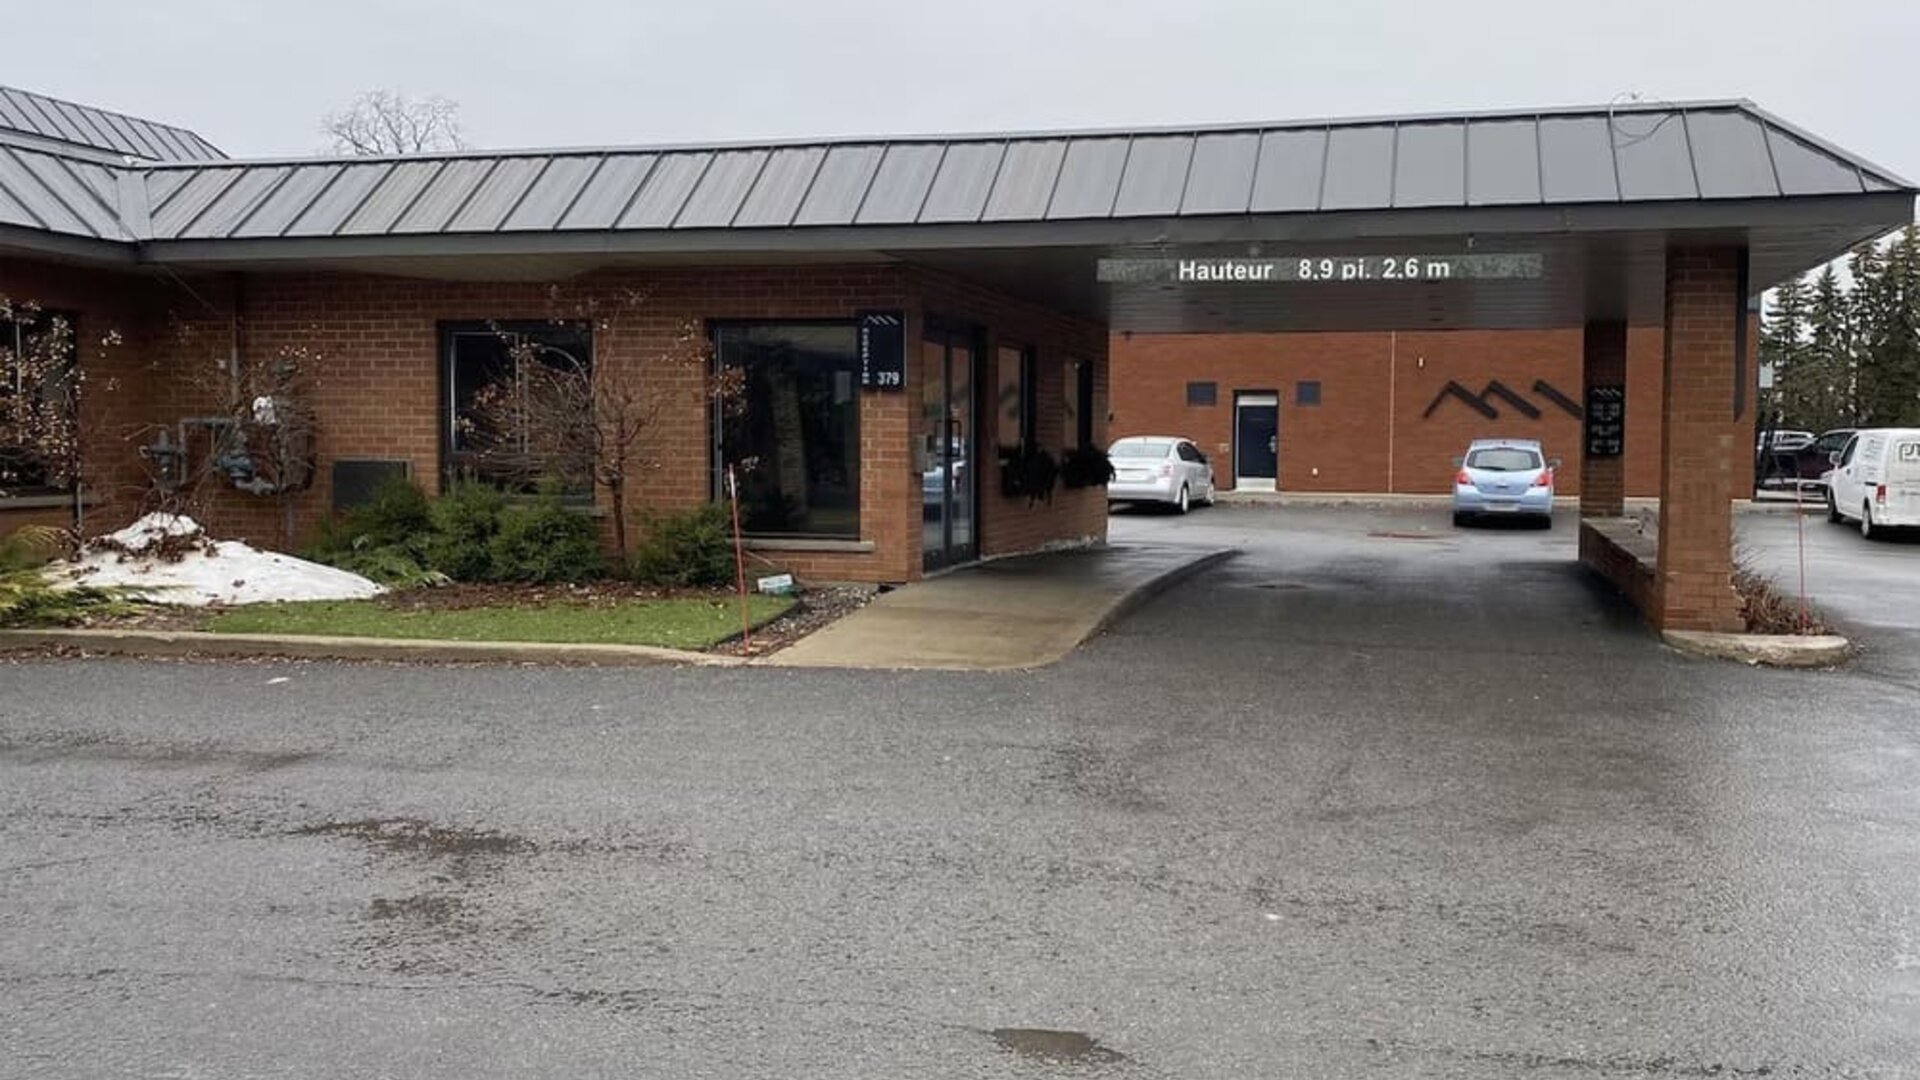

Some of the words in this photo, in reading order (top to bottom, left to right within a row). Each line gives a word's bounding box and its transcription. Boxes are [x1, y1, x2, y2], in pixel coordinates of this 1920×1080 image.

[1178, 260, 1275, 280] Hauteur
[1298, 258, 1335, 280] 8.9
[1382, 257, 1420, 279] 2.6
[1426, 262, 1451, 278] m
[877, 371, 900, 385] 379
